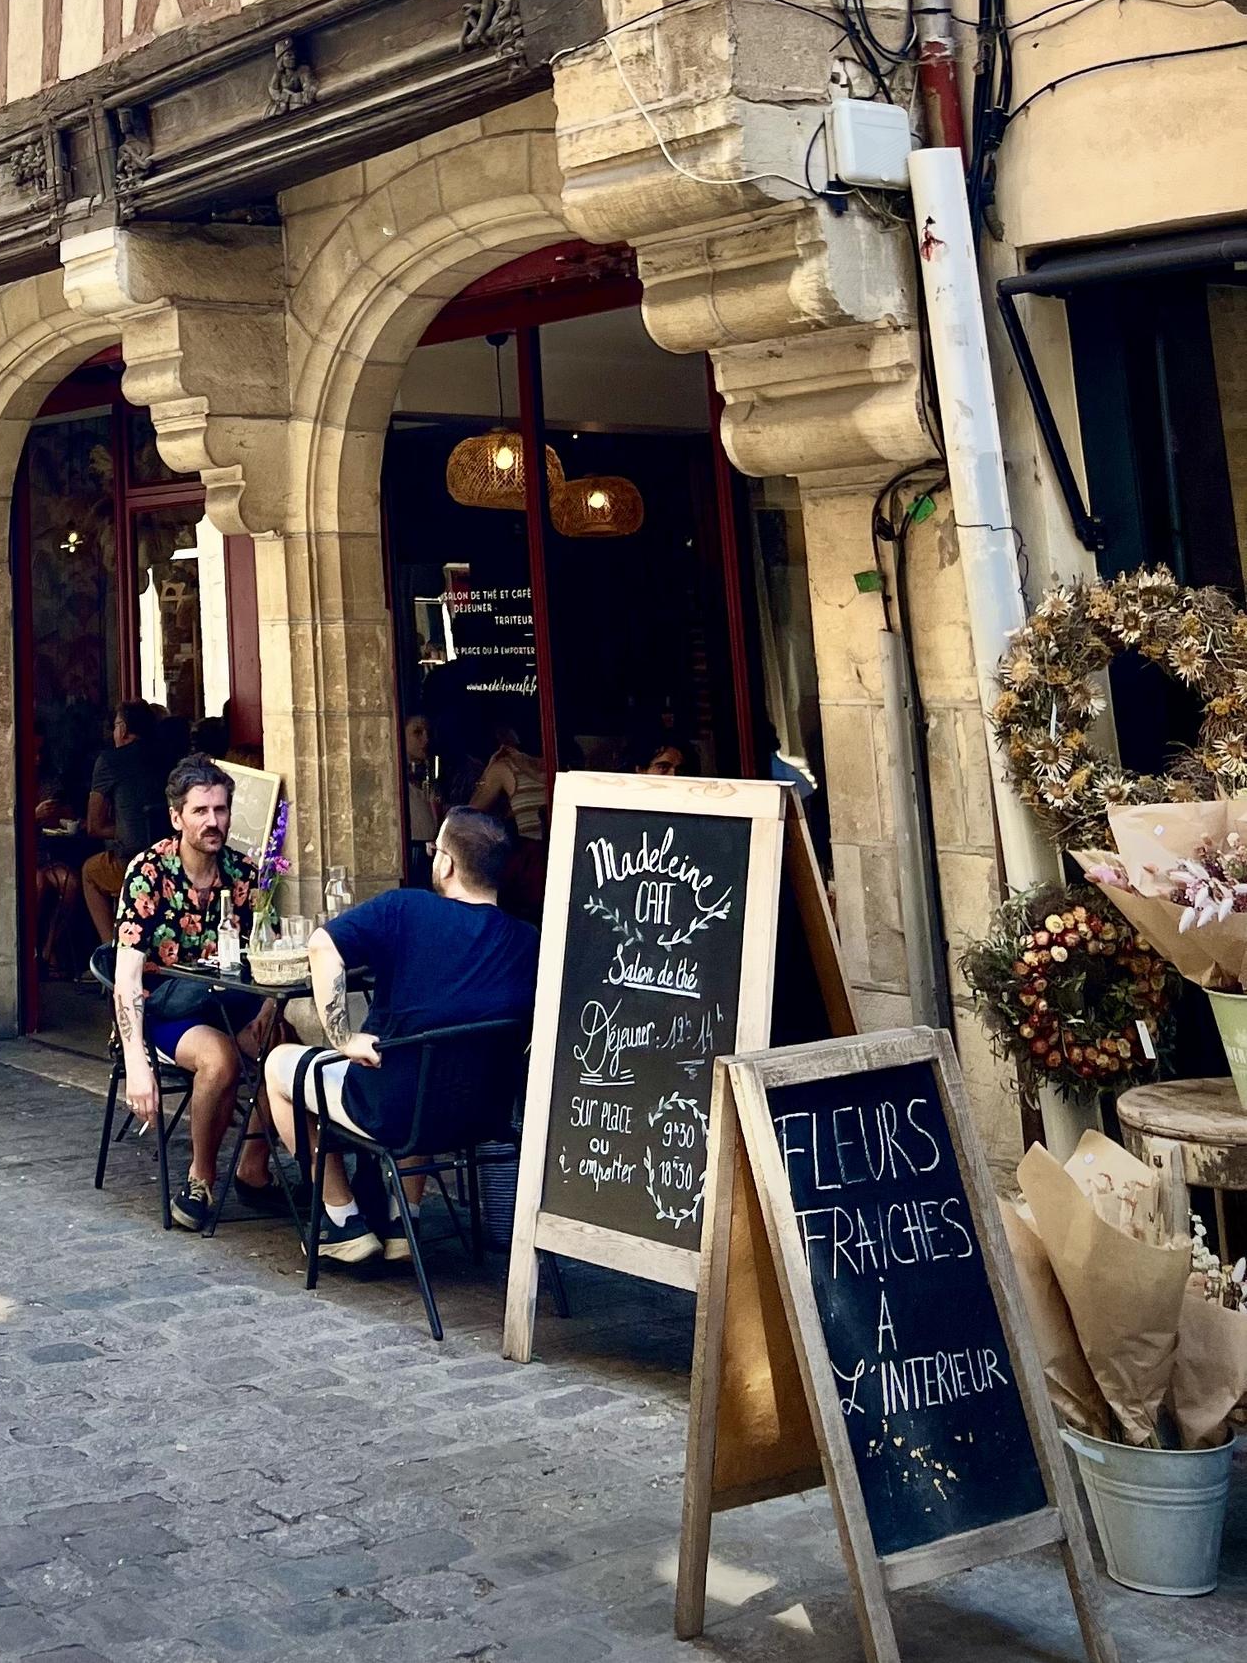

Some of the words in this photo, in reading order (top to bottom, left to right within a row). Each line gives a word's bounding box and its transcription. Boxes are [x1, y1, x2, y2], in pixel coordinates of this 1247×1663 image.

[443, 591, 469, 601] SALON
[470, 590, 481, 600] DE
[482, 588, 497, 600] THÉ
[500, 589, 509, 599] ET
[454, 603, 493, 613] DÉJEUNER
[494, 615, 534, 625] TRAITEUR
[461, 646, 481, 655] PLACE
[482, 646, 492, 655] OU
[585, 826, 733, 912] Madeleine
[657, 958, 674, 987] de
[676, 957, 699, 990] thé
[774, 1098, 941, 1190] FLEURS
[831, 1348, 1008, 1416] L'INTERIEUR
